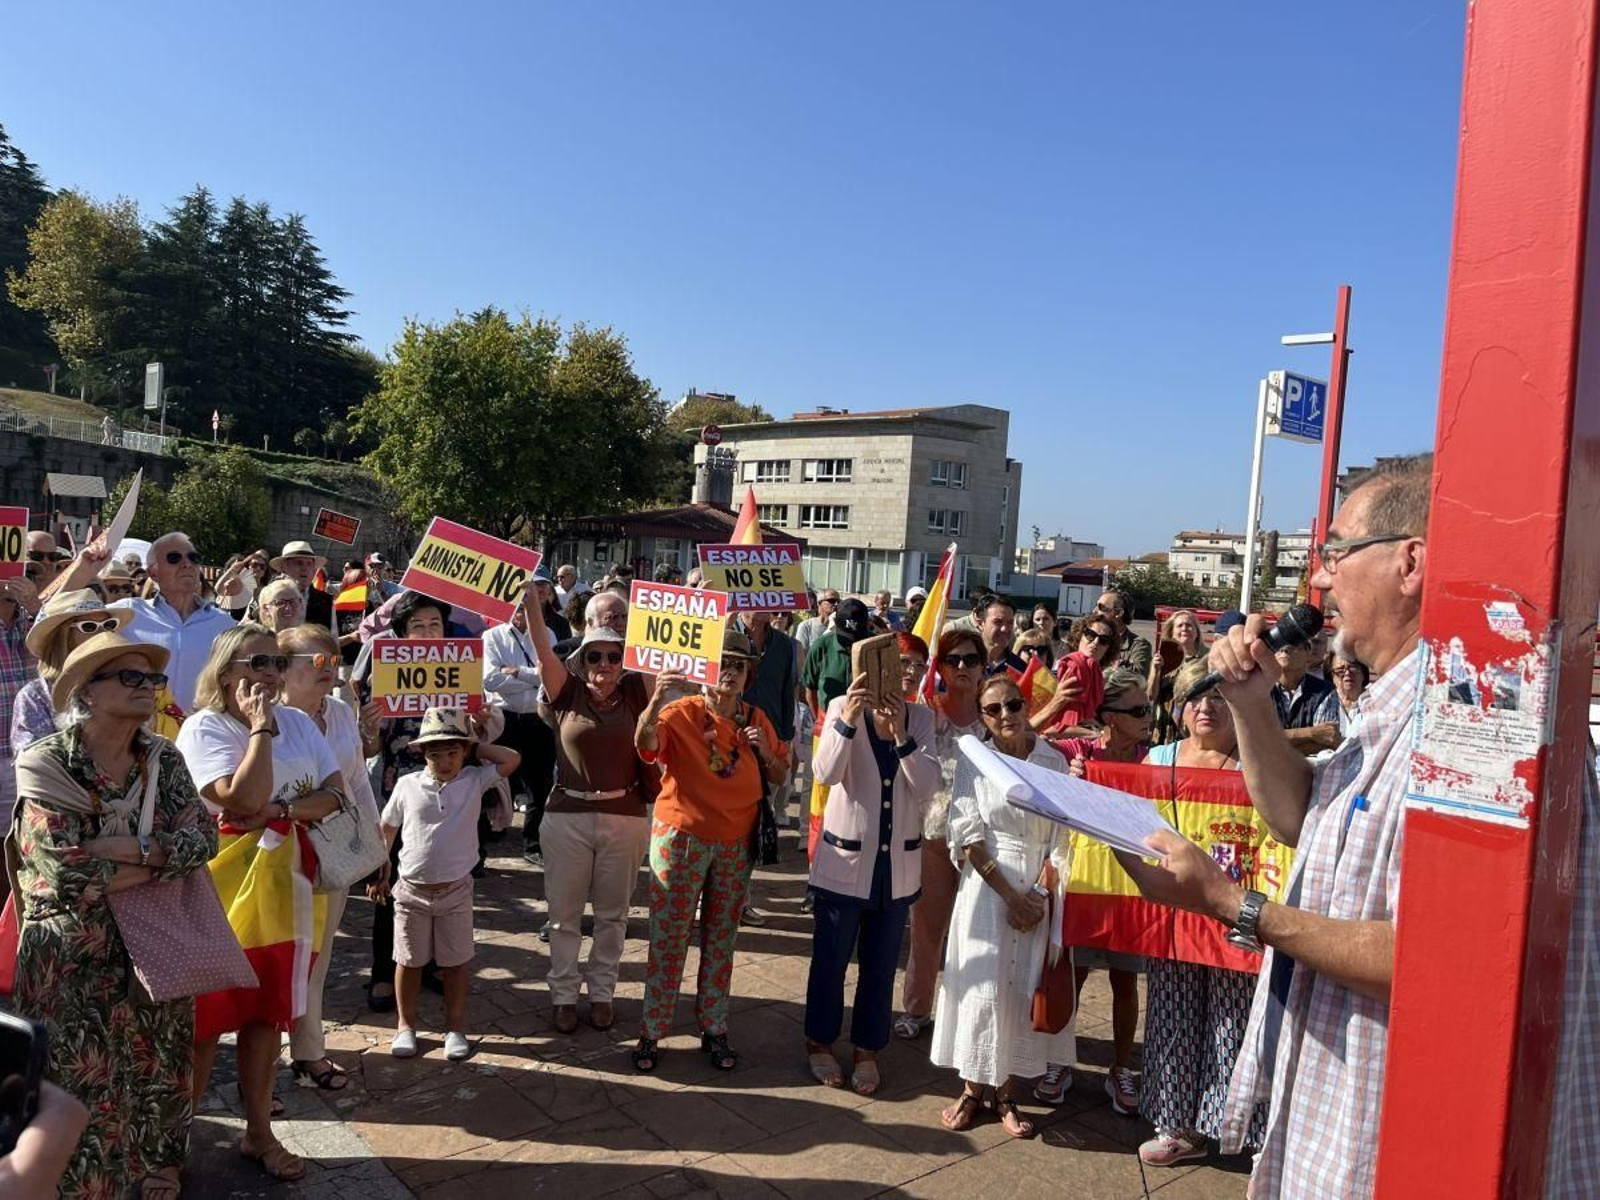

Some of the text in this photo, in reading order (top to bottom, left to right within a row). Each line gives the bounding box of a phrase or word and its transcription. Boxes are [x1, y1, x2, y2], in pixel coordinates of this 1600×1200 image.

[1285, 378, 1303, 409] P
[707, 547, 794, 565] ESPAÑA
[416, 543, 526, 602] AMNISTÍA NO
[725, 568, 784, 588] NO SE
[635, 588, 719, 621] ESPAÑA
[646, 615, 703, 649] NO SE
[380, 641, 476, 663] ESPAÑA
[635, 645, 708, 679] VENDE
[396, 667, 459, 689] NO SE
[385, 692, 469, 712] VENDE
